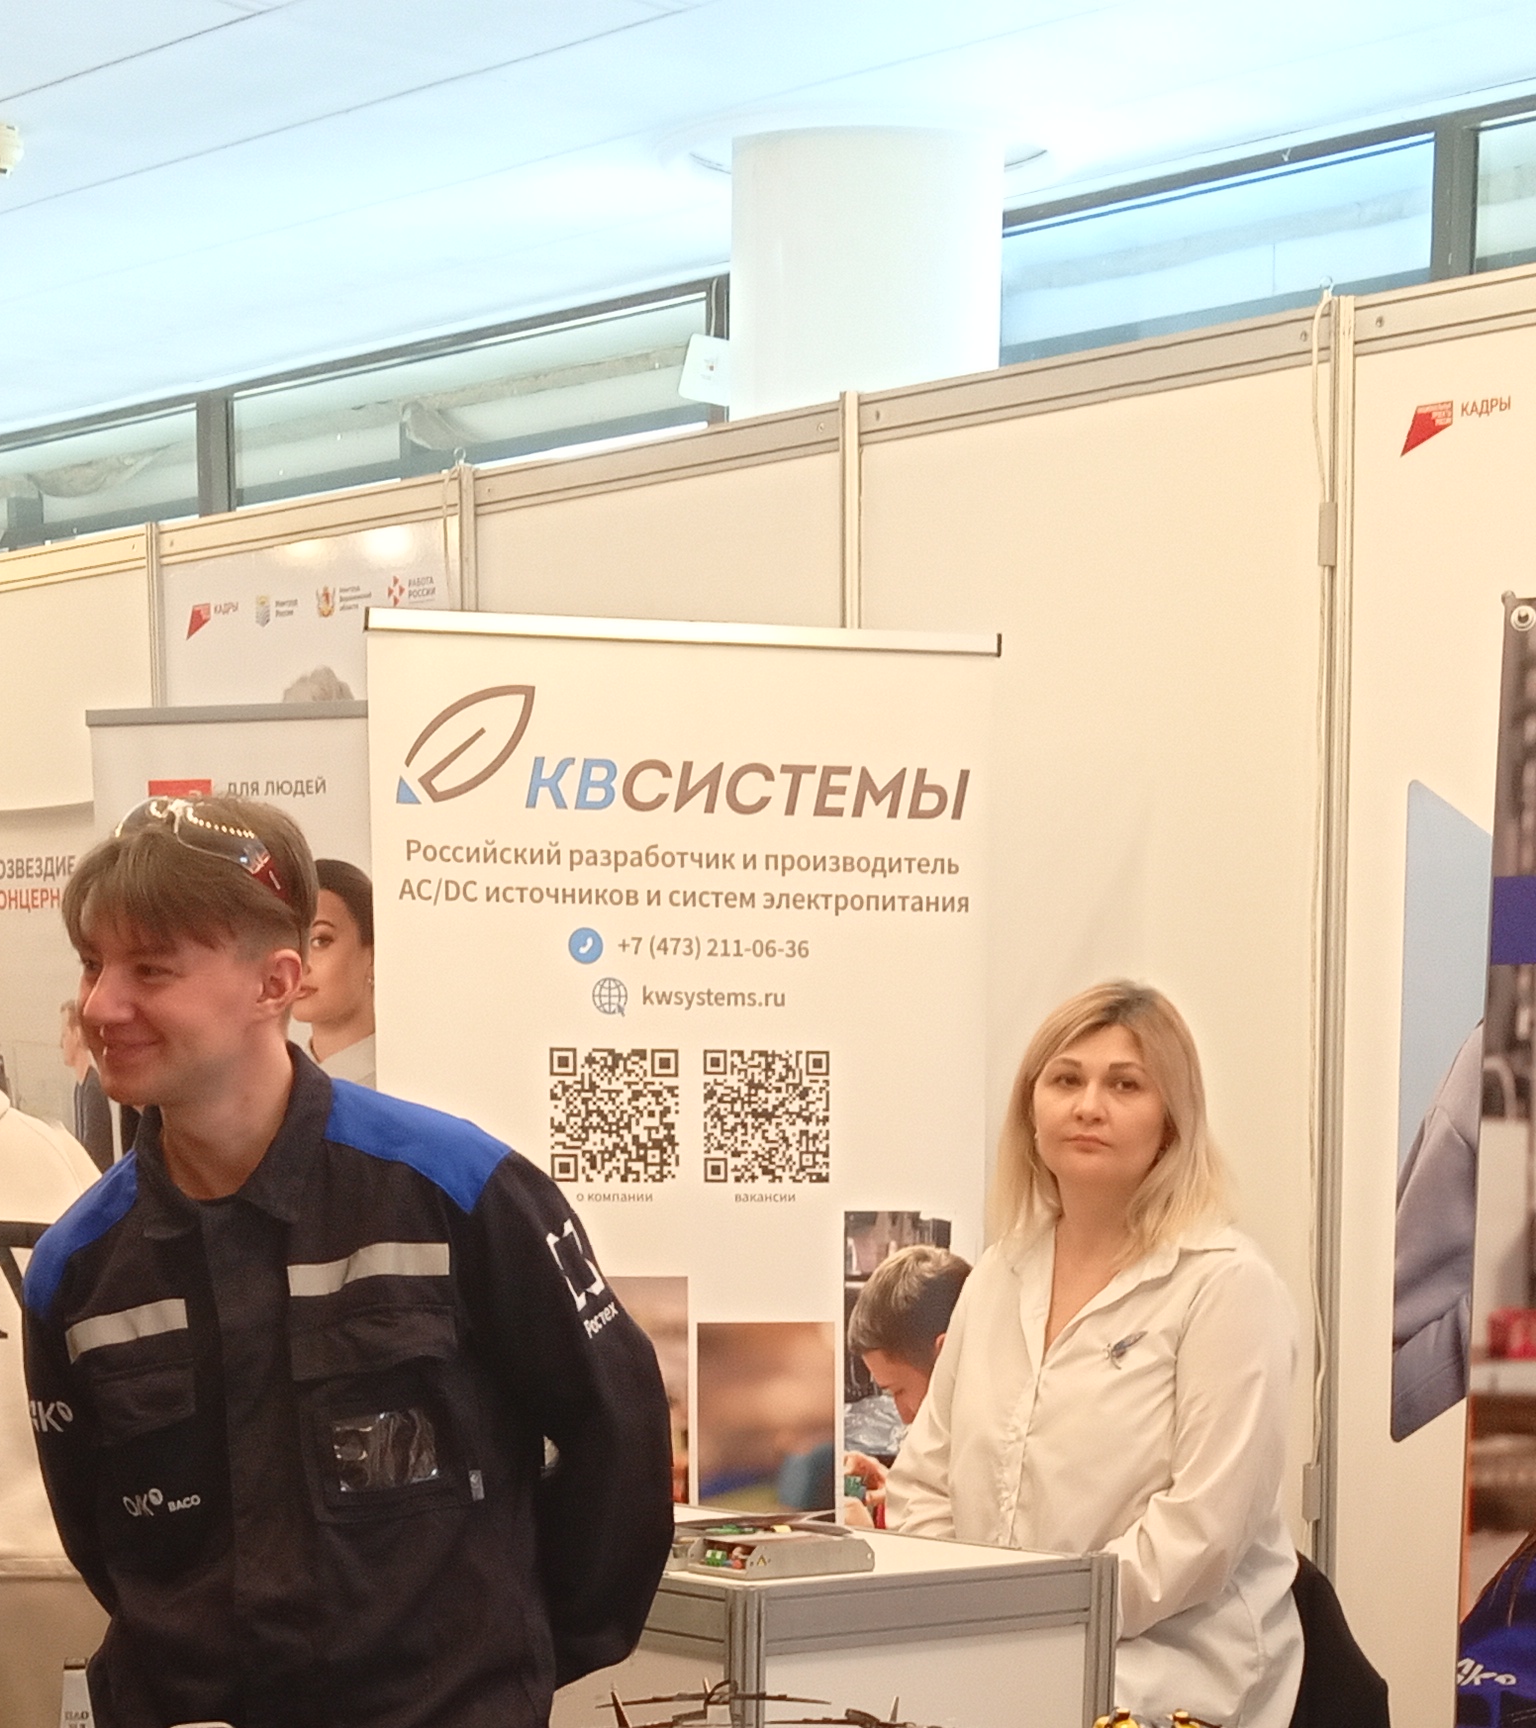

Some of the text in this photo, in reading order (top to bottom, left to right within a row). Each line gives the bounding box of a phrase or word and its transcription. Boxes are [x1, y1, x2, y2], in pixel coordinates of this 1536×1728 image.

[1460, 396, 1512, 418] КАДРЫ
[264, 776, 327, 798] ЛЮДЕЙ
[524, 756, 971, 821] КВСИСТЕМЫ
[405, 838, 960, 879] Российский разработчик и производитель
[485, 884, 639, 908] источников
[646, 891, 662, 907] и
[668, 890, 756, 909] систем
[762, 888, 970, 916] электропитания
[617, 935, 810, 960] +7 (473) 211-06-36
[642, 985, 786, 1011] kwsystems.ru
[576, 1192, 654, 1203] о компании
[734, 1192, 796, 1203] вакансии
[583, 1301, 619, 1339] Ростех
[167, 1494, 201, 1513] ВАСО
